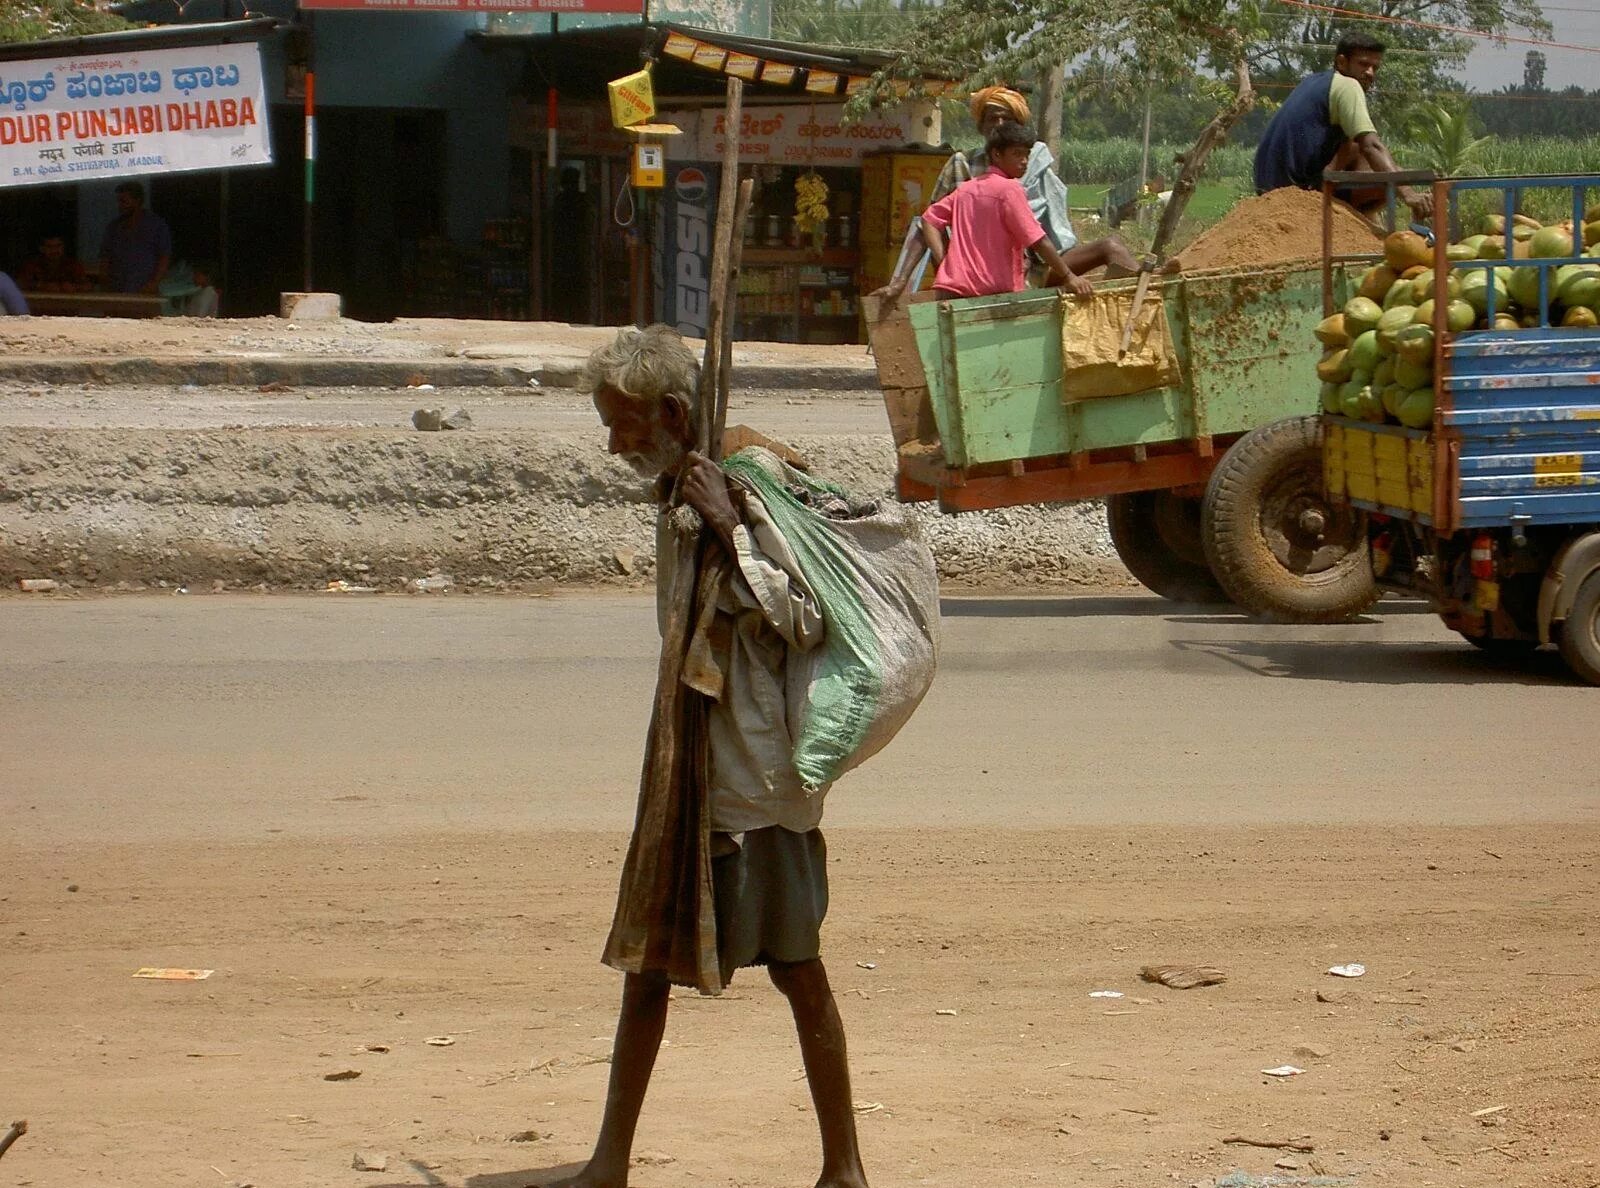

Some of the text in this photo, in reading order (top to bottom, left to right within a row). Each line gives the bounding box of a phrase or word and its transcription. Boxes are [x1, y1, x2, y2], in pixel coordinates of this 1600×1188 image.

[0, 96, 256, 145] DUR PUNJABI DHABA
